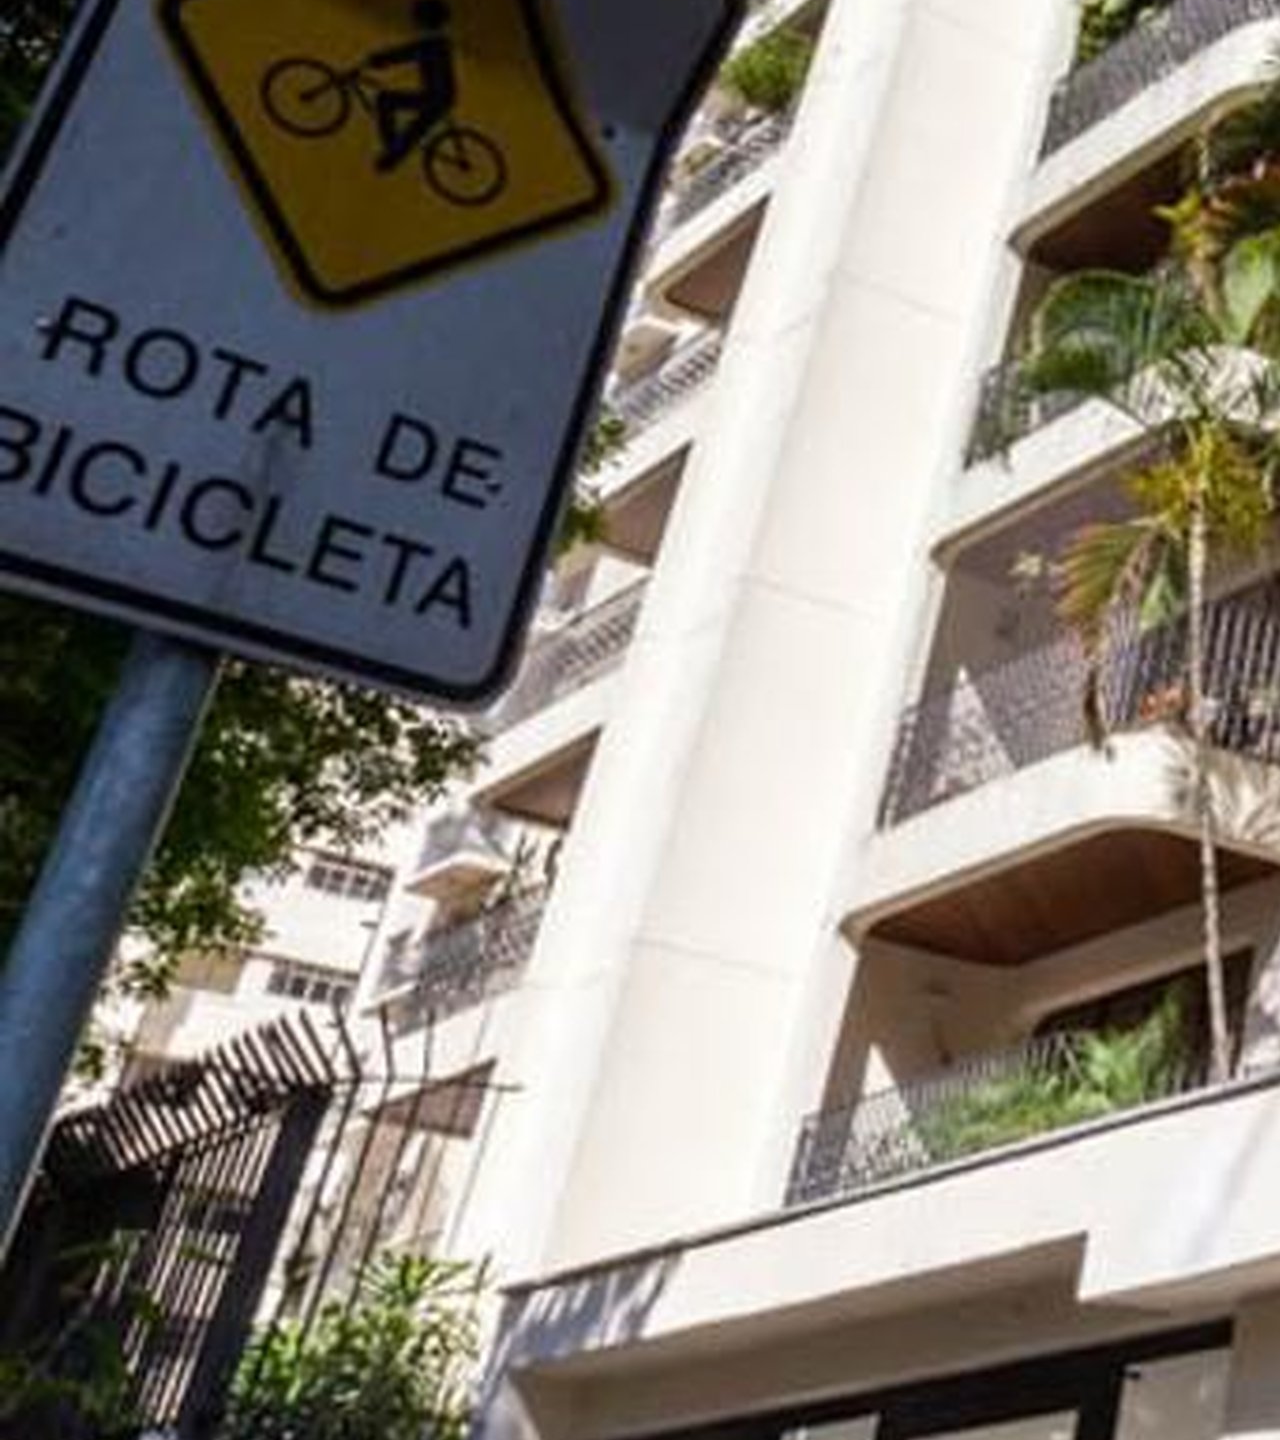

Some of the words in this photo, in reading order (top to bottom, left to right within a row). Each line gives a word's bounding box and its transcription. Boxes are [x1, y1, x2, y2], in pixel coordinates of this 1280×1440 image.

[38, 295, 315, 449] ROTA
[375, 413, 503, 509] DE
[0, 405, 474, 629] BICICLETA
